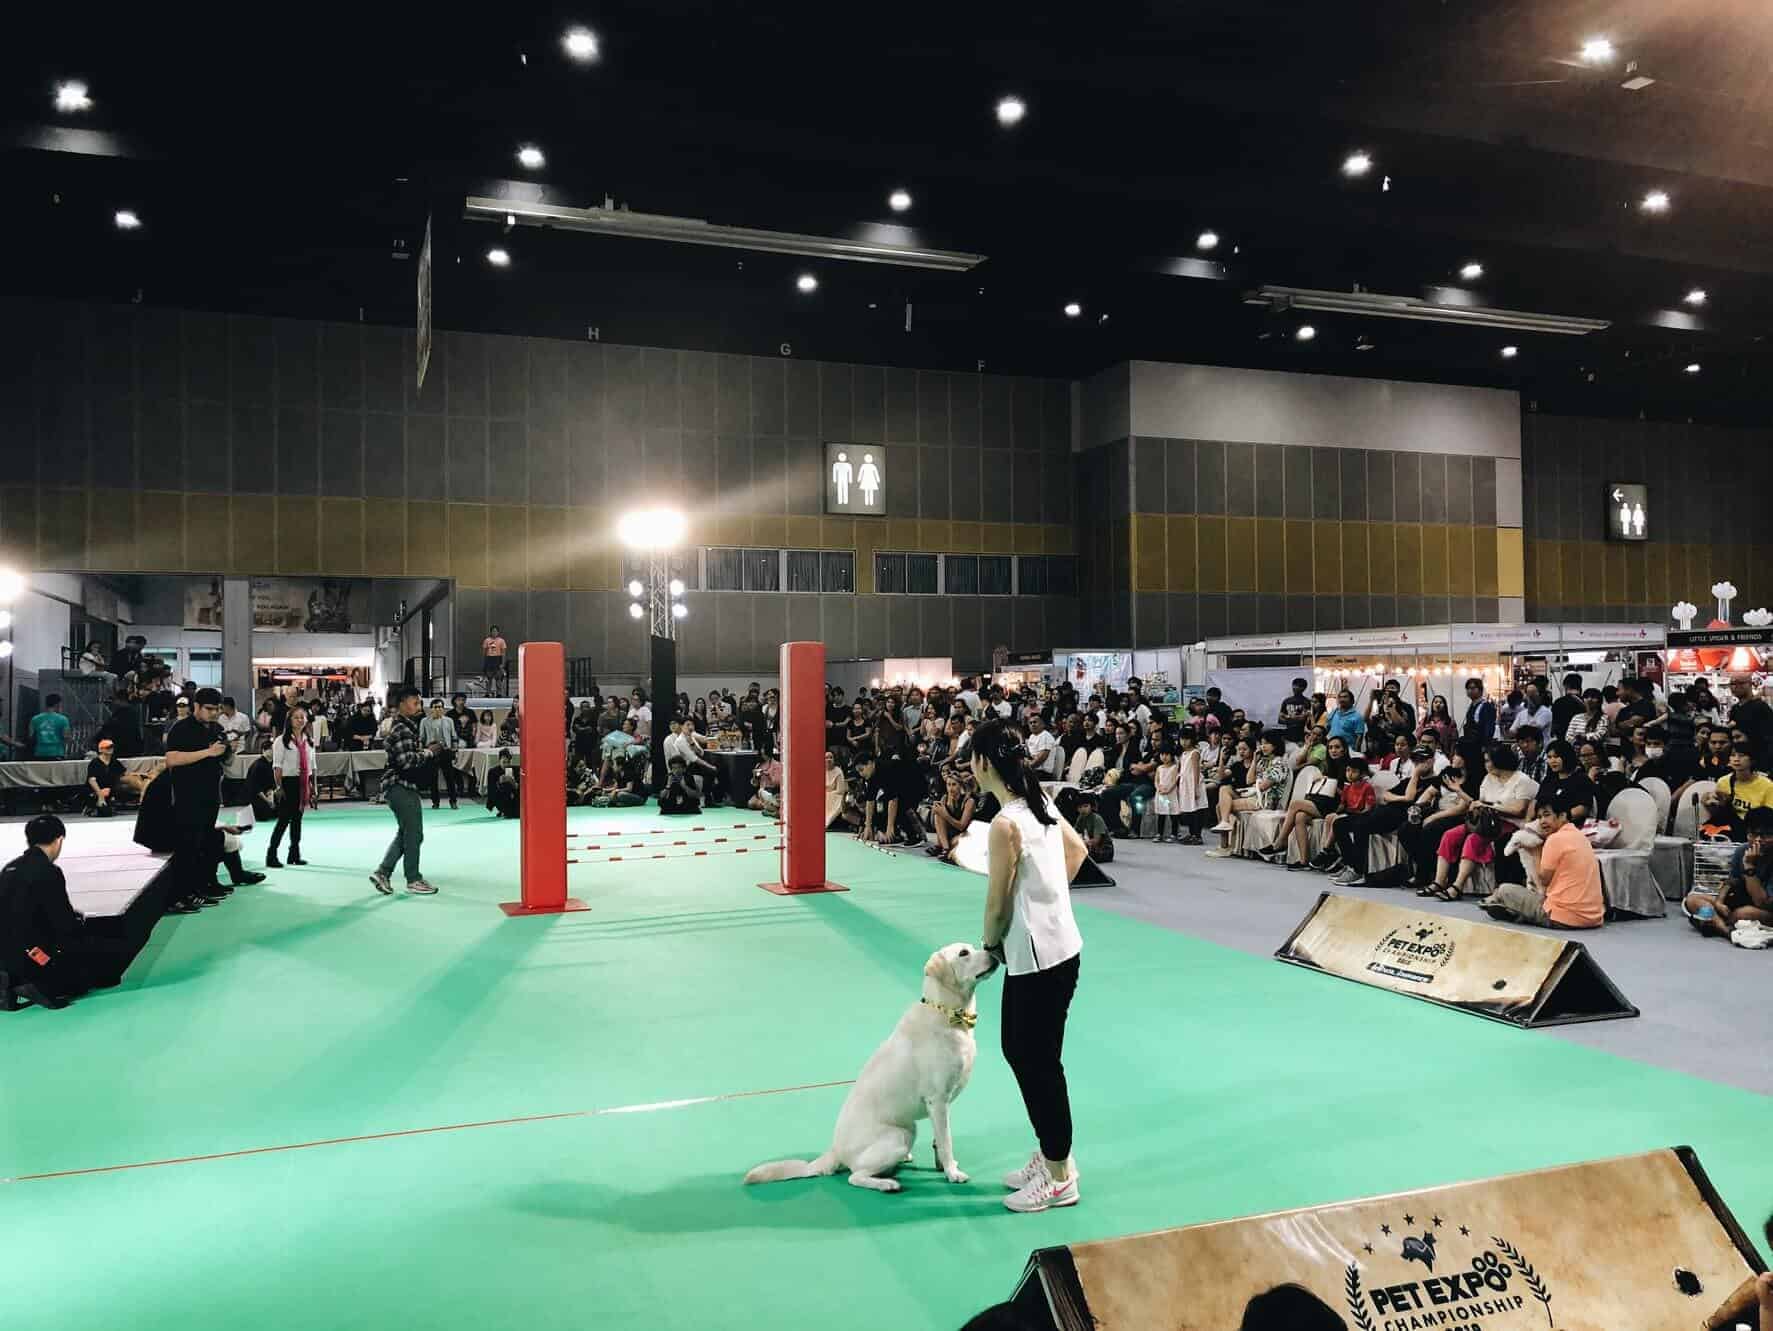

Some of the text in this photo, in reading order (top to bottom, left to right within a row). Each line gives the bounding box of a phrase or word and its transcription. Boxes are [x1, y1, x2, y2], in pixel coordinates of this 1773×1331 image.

[587, 327, 600, 341] H
[780, 343, 792, 356] G
[976, 359, 985, 373] F
[1387, 938, 1446, 957] PET EXPO
[1368, 1259, 1509, 1315] PET EXPO
[1384, 1295, 1524, 1331] CHAMPIONSHIP
